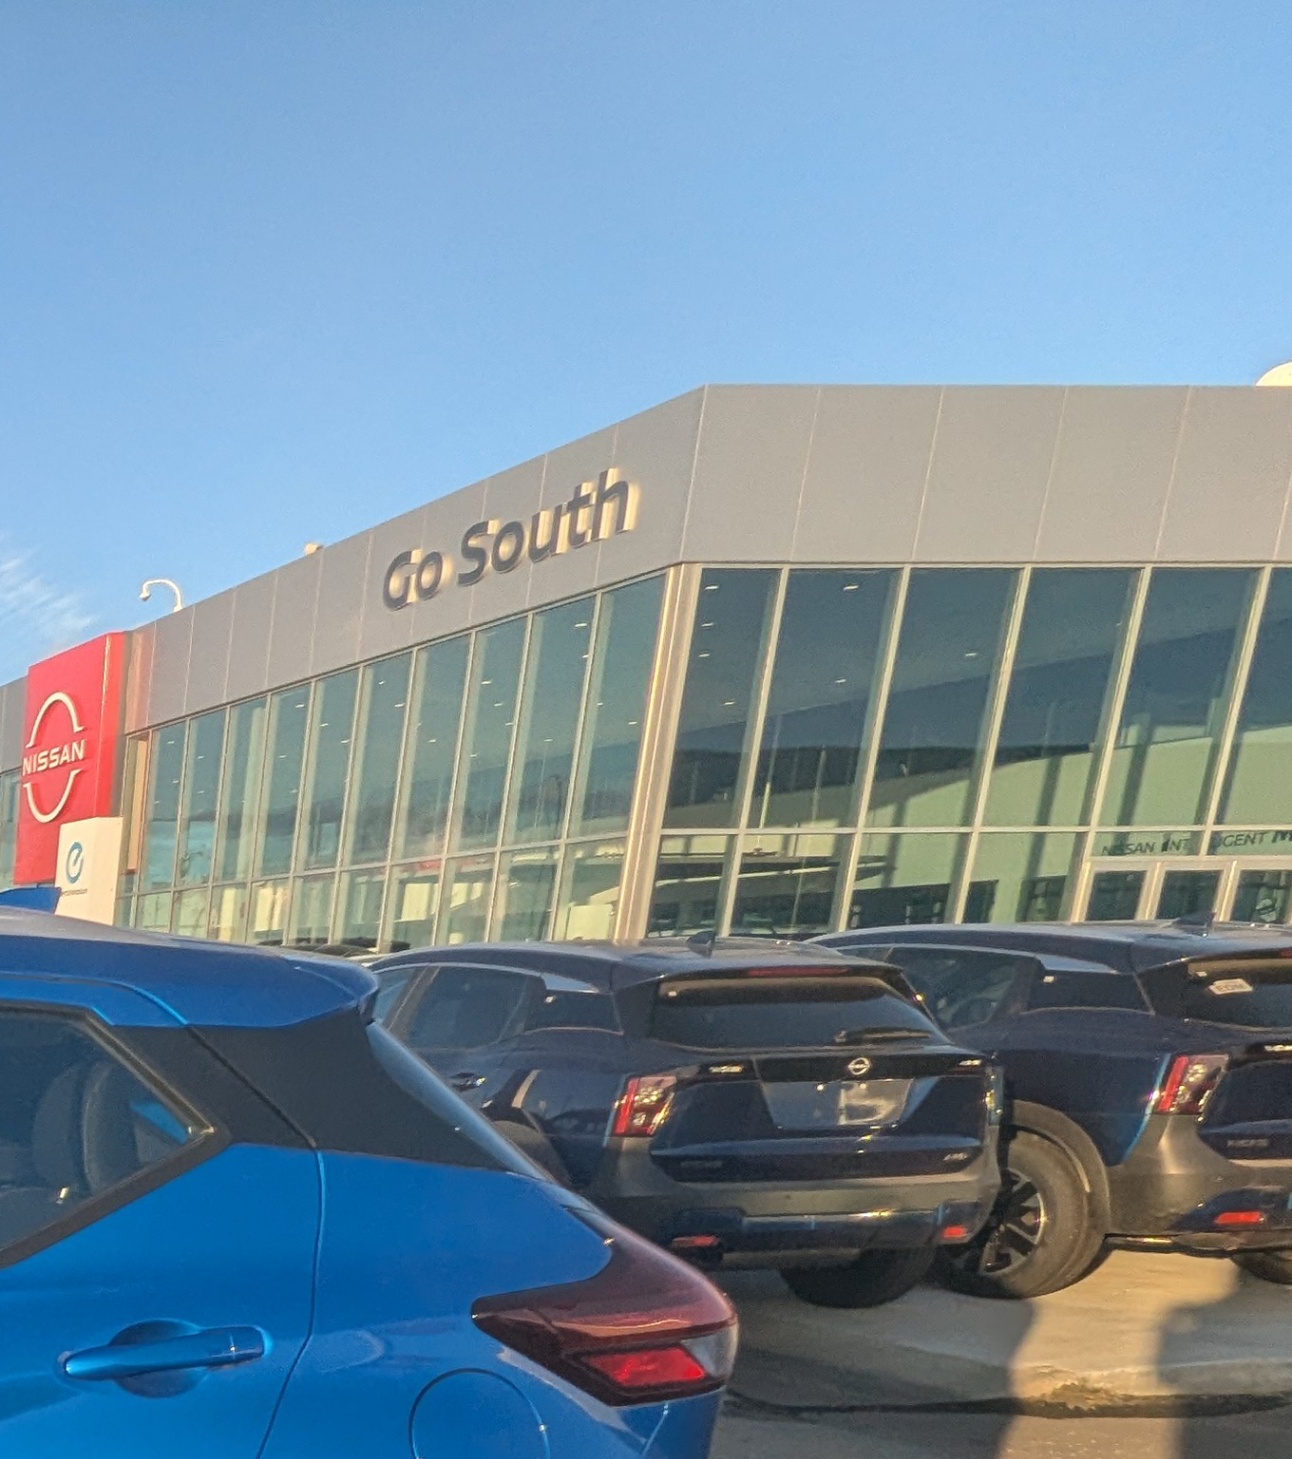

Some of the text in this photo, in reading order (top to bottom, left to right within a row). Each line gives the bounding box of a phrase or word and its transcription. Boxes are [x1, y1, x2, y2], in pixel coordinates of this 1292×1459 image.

[383, 467, 638, 611] Go South
[22, 740, 85, 776] NISSAN
